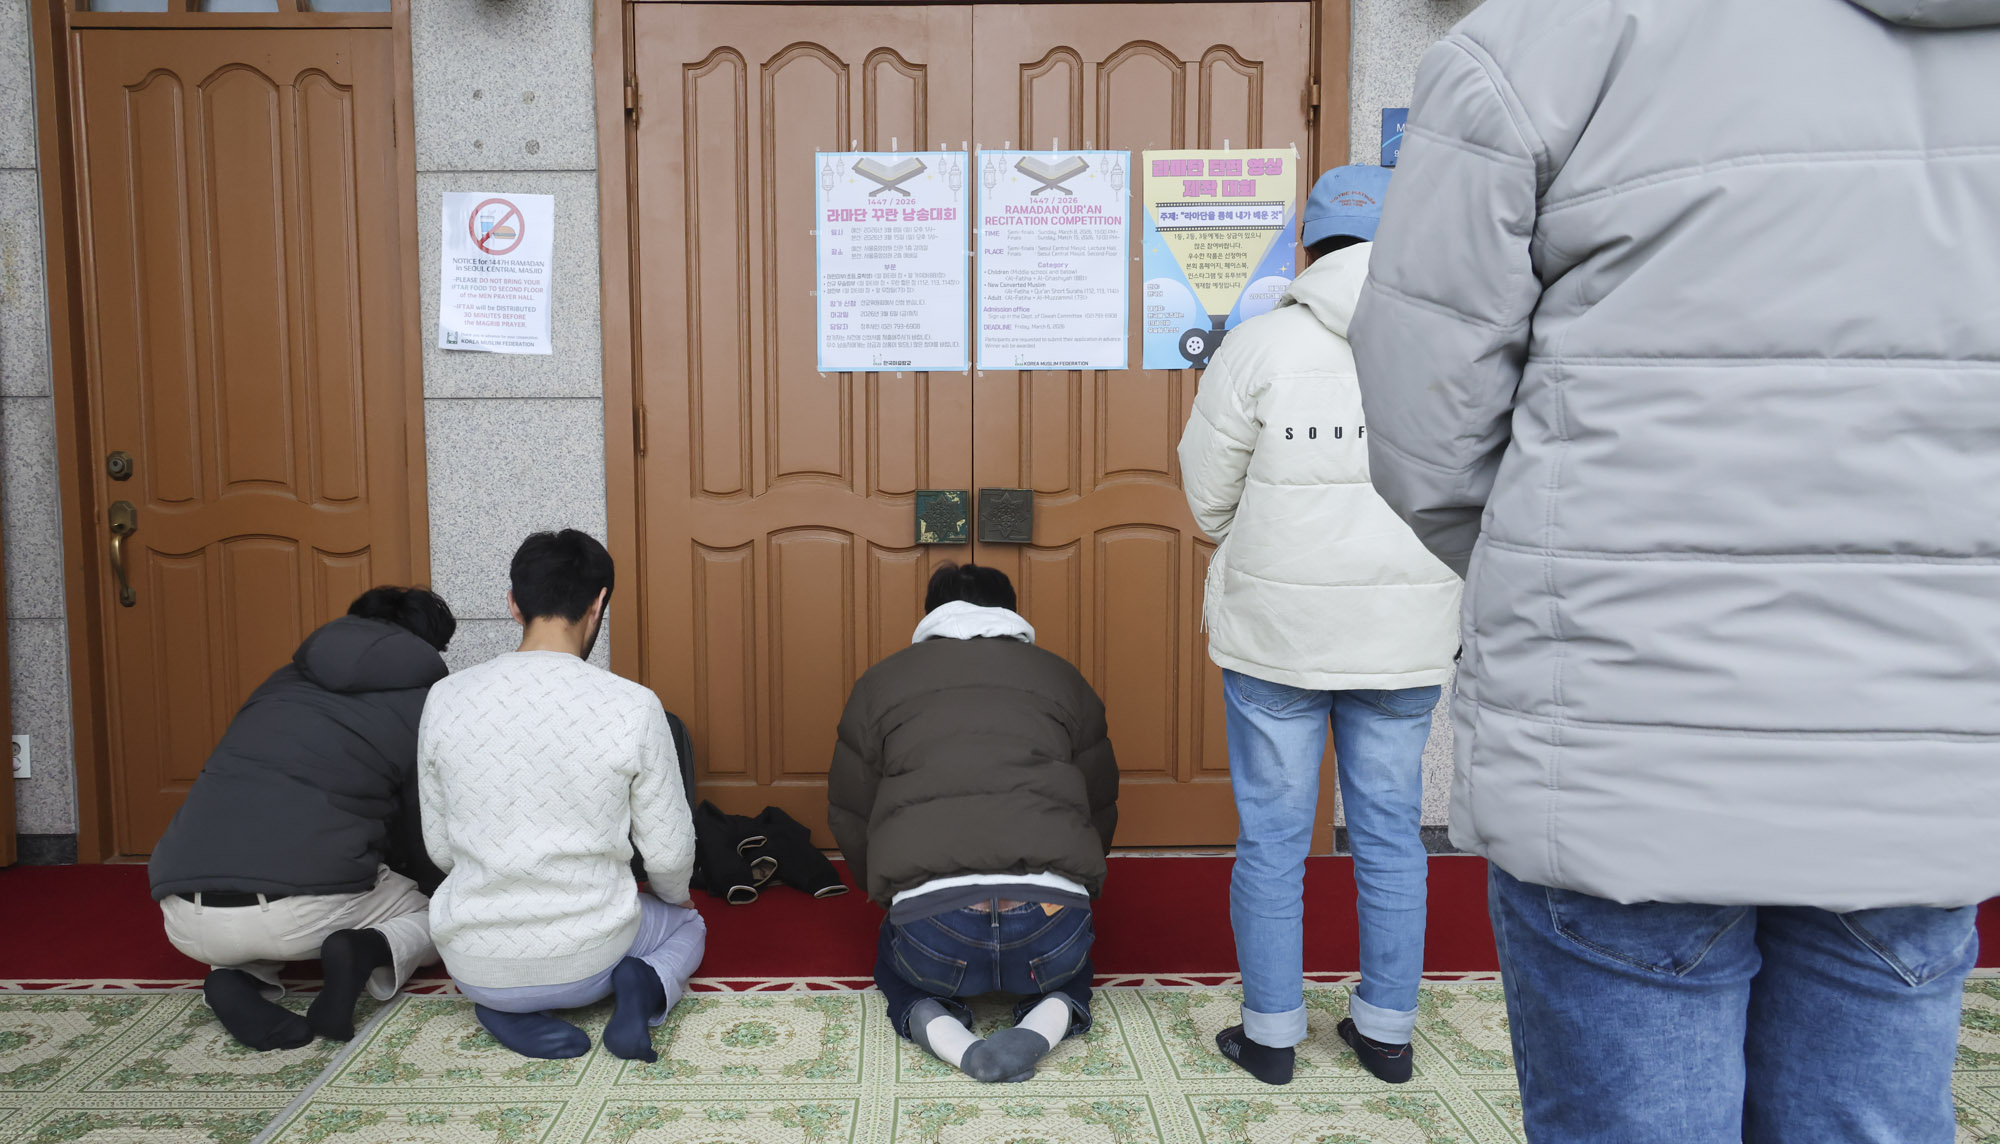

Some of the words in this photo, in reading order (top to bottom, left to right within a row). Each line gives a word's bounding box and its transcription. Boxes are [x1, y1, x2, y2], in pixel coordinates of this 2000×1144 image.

[1152, 159, 1204, 177] 라마단
[1208, 159, 1242, 176] 단편
[1247, 158, 1283, 176] 영상
[1183, 180, 1217, 197] 제작
[1222, 179, 1256, 197] 대회
[827, 208, 868, 222] 라마단
[872, 208, 898, 222] 꾸란
[902, 207, 957, 221] 낭송대회
[1005, 205, 1059, 214] RAMADAN
[1062, 205, 1102, 215] QUR'AN
[1160, 212, 1179, 221] 주제:
[1181, 211, 1216, 221] "라마단을
[1218, 211, 1234, 220] 통해
[1235, 211, 1251, 220] 내가
[1253, 211, 1268, 220] 배운
[1271, 210, 1283, 220] 것"
[985, 216, 1048, 226] RECITATION
[1051, 216, 1122, 225] COMPETITION
